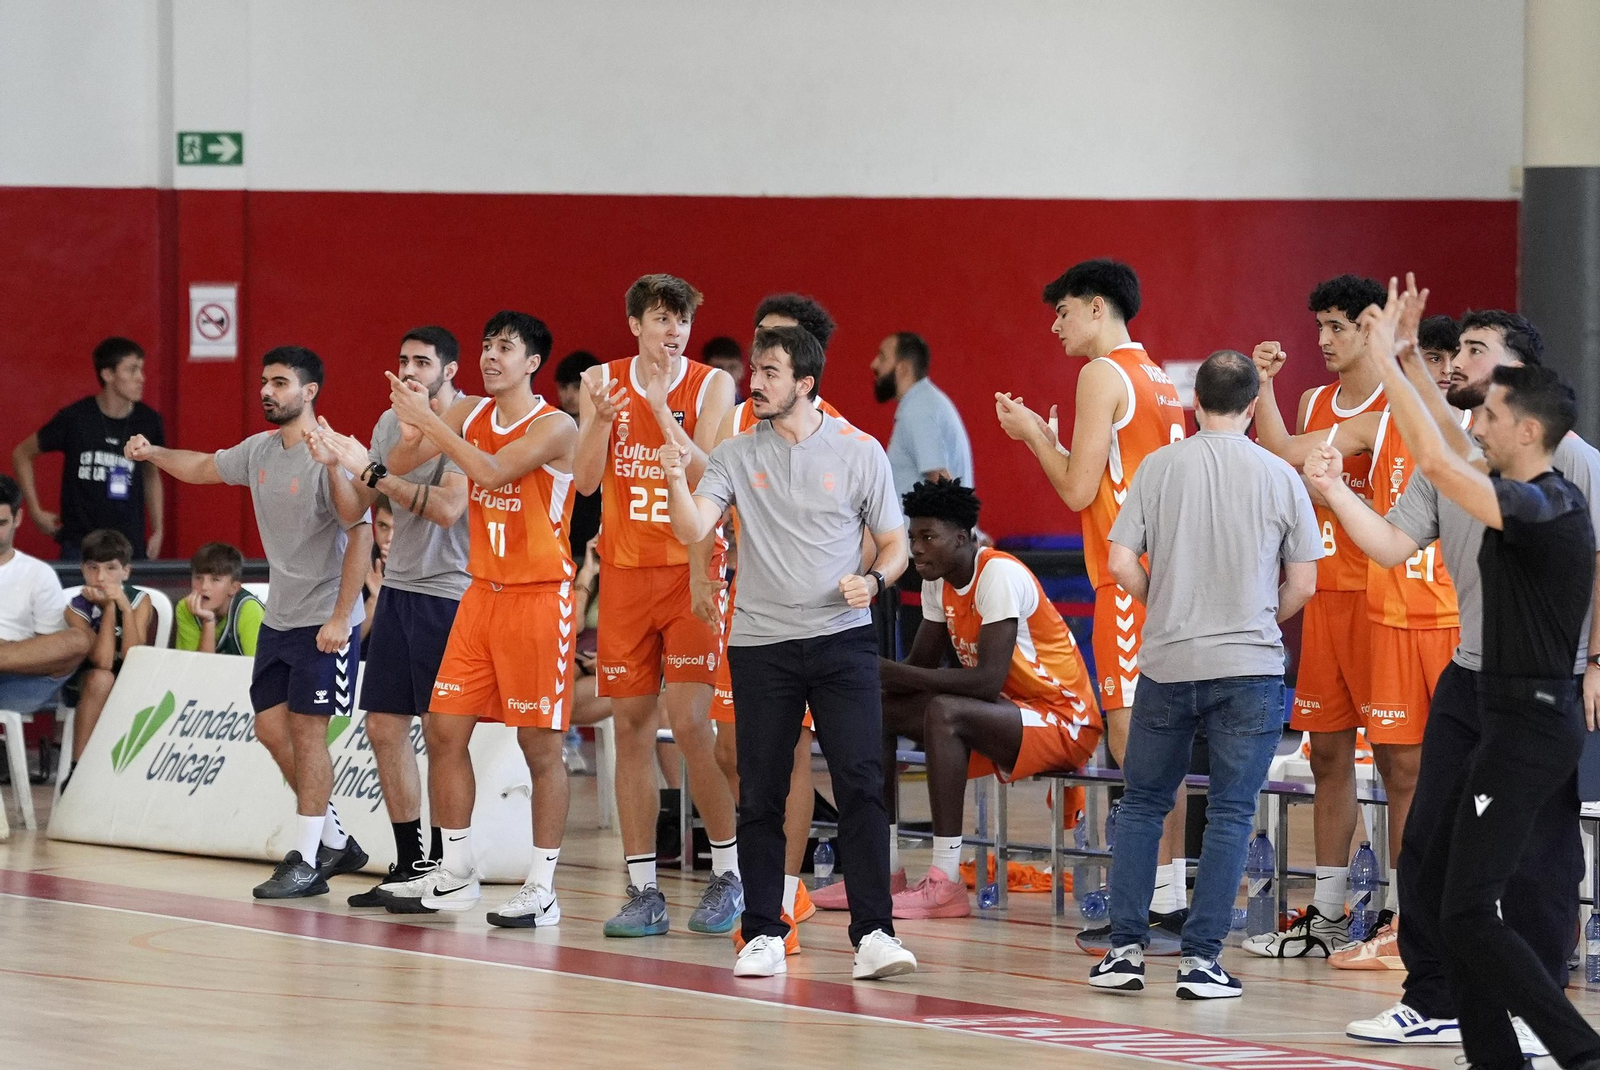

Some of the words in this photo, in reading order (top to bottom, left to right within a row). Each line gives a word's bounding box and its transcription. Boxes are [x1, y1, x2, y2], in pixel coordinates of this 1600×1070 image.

[1351, 478, 1366, 488] del
[630, 486, 671, 522] 22
[487, 521, 506, 557] 11
[1405, 547, 1436, 582] 21
[667, 655, 704, 669] frigicoll
[1294, 697, 1321, 709] PULEVA
[1372, 708, 1406, 719] PULEVA
[168, 699, 259, 743] Fundaci
[146, 742, 226, 797] Unicaja
[332, 754, 385, 813] Unica
